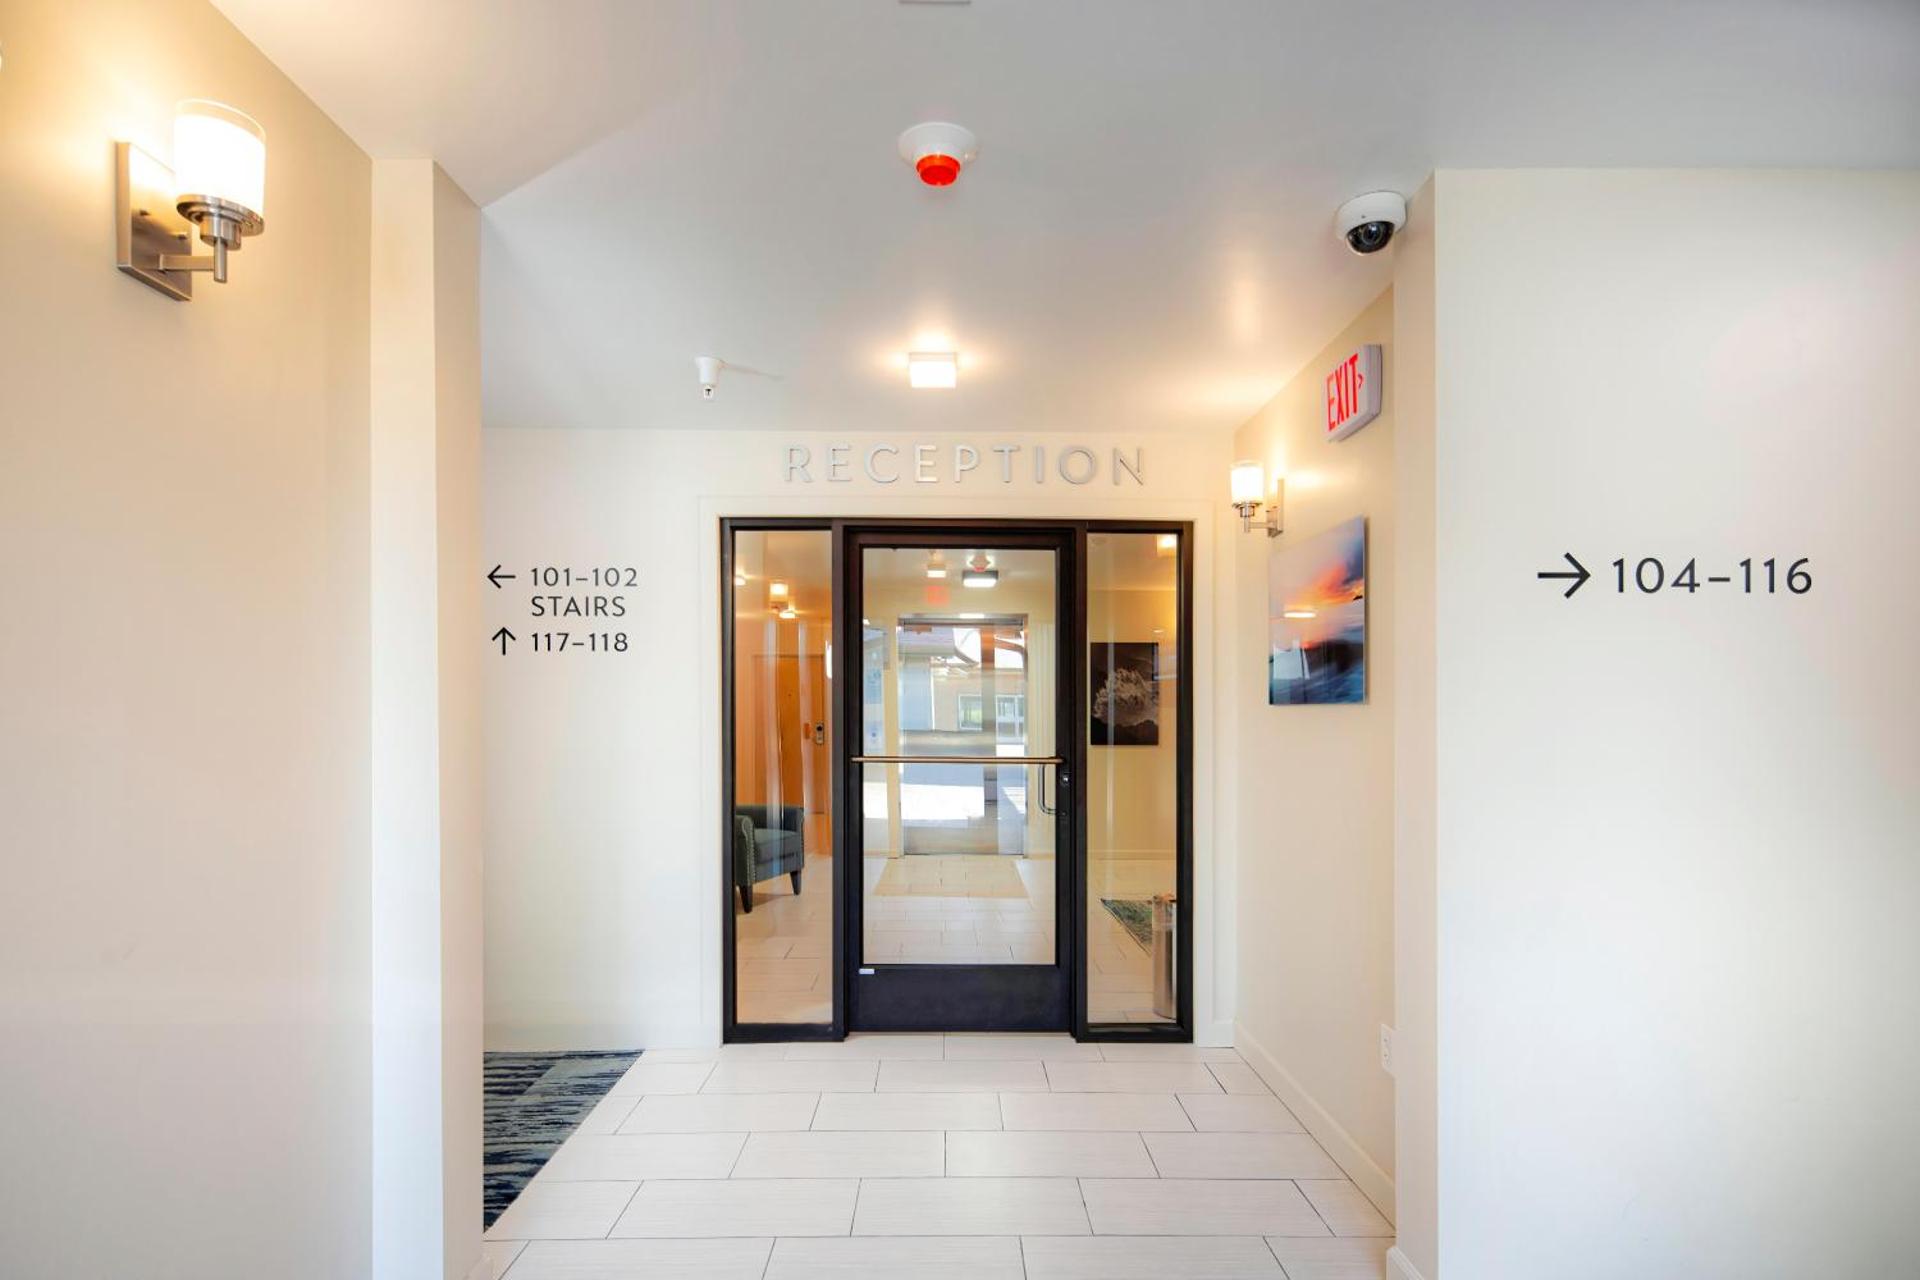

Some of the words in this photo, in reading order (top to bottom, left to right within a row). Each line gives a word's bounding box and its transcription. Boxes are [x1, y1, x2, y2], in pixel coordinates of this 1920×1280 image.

[1326, 352, 1359, 431] EXIT
[784, 444, 1146, 485] RECEPTION
[530, 566, 638, 588] 101-102
[1613, 556, 1812, 595] 104-116
[530, 595, 626, 618] STAIRS
[530, 631, 629, 653] 117-118
